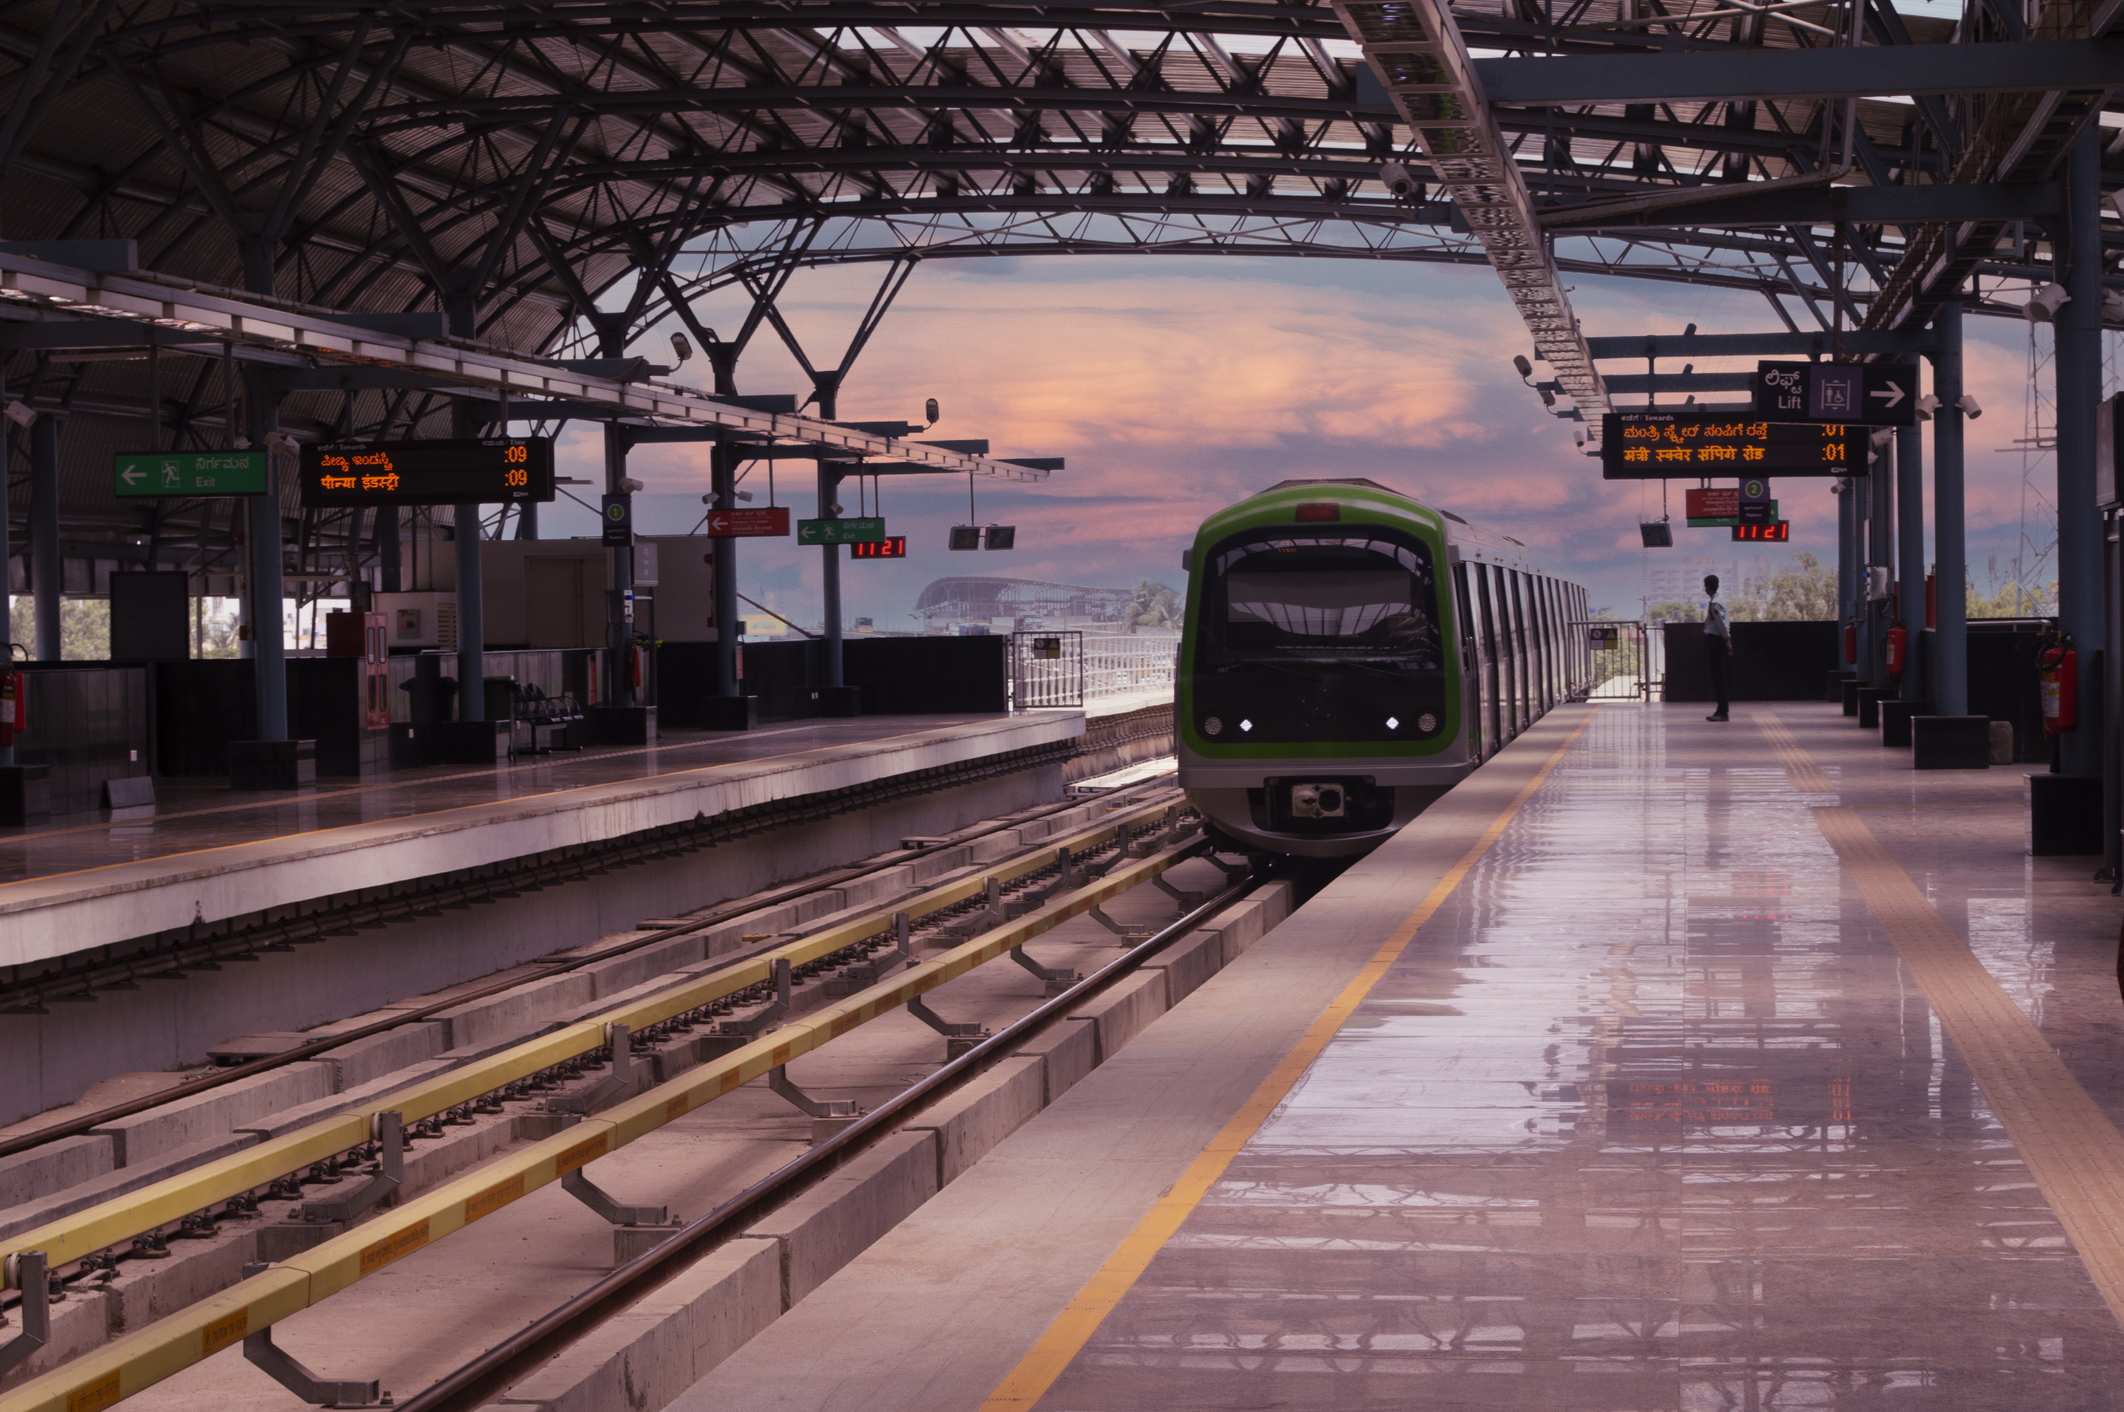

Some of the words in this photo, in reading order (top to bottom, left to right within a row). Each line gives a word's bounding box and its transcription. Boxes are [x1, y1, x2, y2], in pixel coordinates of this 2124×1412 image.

[1765, 369, 1802, 394] ಲಿಫ್ಟ್
[1778, 396, 1802, 409] Lift
[1623, 447, 1650, 462] मंत्री
[1742, 445, 1765, 461] रोड
[196, 456, 249, 470] ನಿರ್ಗಮನ
[196, 476, 215, 487] Exit
[1751, 485, 1757, 493] 2
[614, 508, 618, 516] 1
